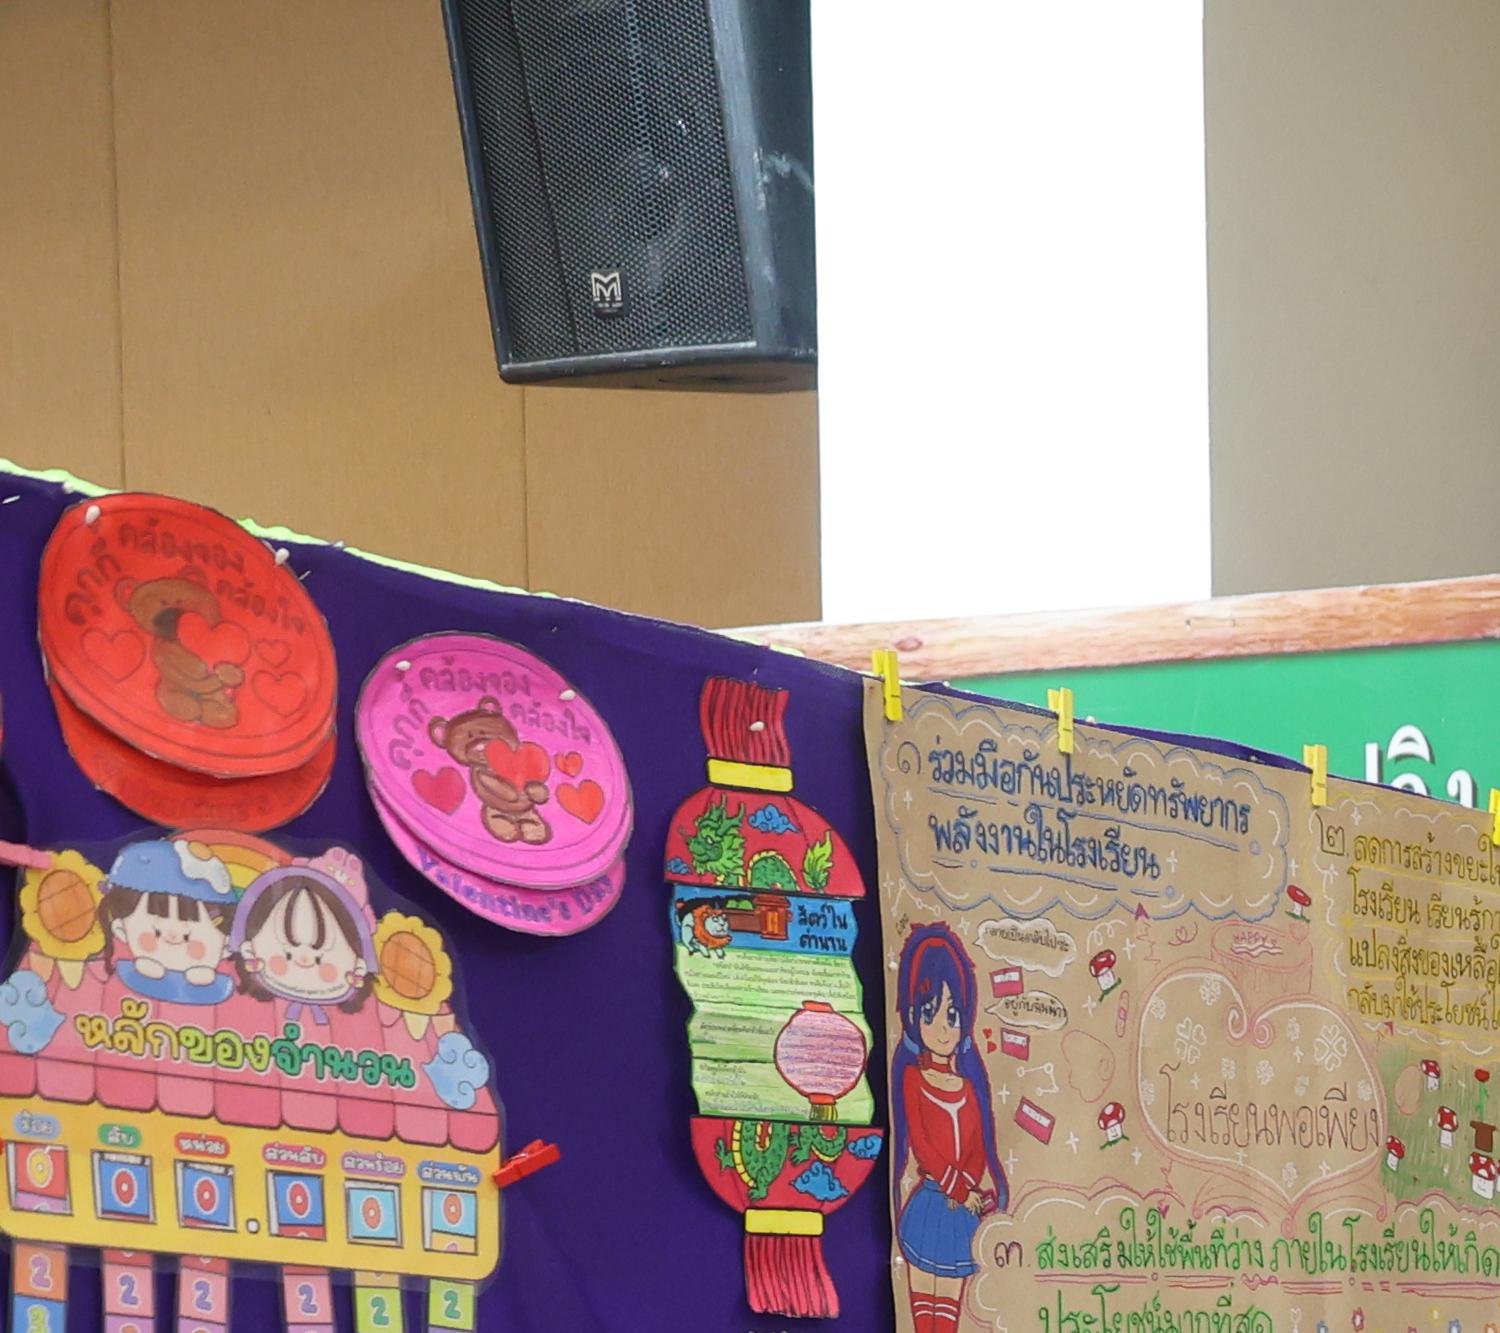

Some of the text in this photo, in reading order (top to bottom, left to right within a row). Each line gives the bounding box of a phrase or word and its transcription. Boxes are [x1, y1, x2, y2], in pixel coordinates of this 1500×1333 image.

[928, 734, 1252, 835] ร่วมมือกันประหยัดทรัพยากร
[928, 804, 1162, 880] พลังงานในโรงเรียน
[797, 902, 849, 931] สัตว์ใน
[1346, 866, 1421, 925] โรงเรียน
[799, 928, 849, 952] ตำนาน
[73, 997, 418, 1092] หลักของจำนวน
[1159, 1062, 1380, 1152] โรงเรียนพอเพียง
[30, 1257, 52, 1288] 2
[1035, 1207, 1264, 1271] ส่งเสริมให้ใช้พื้นที่ว่าง
[1269, 1207, 1500, 1278] ภายในโรงเรียนให้เกิด
